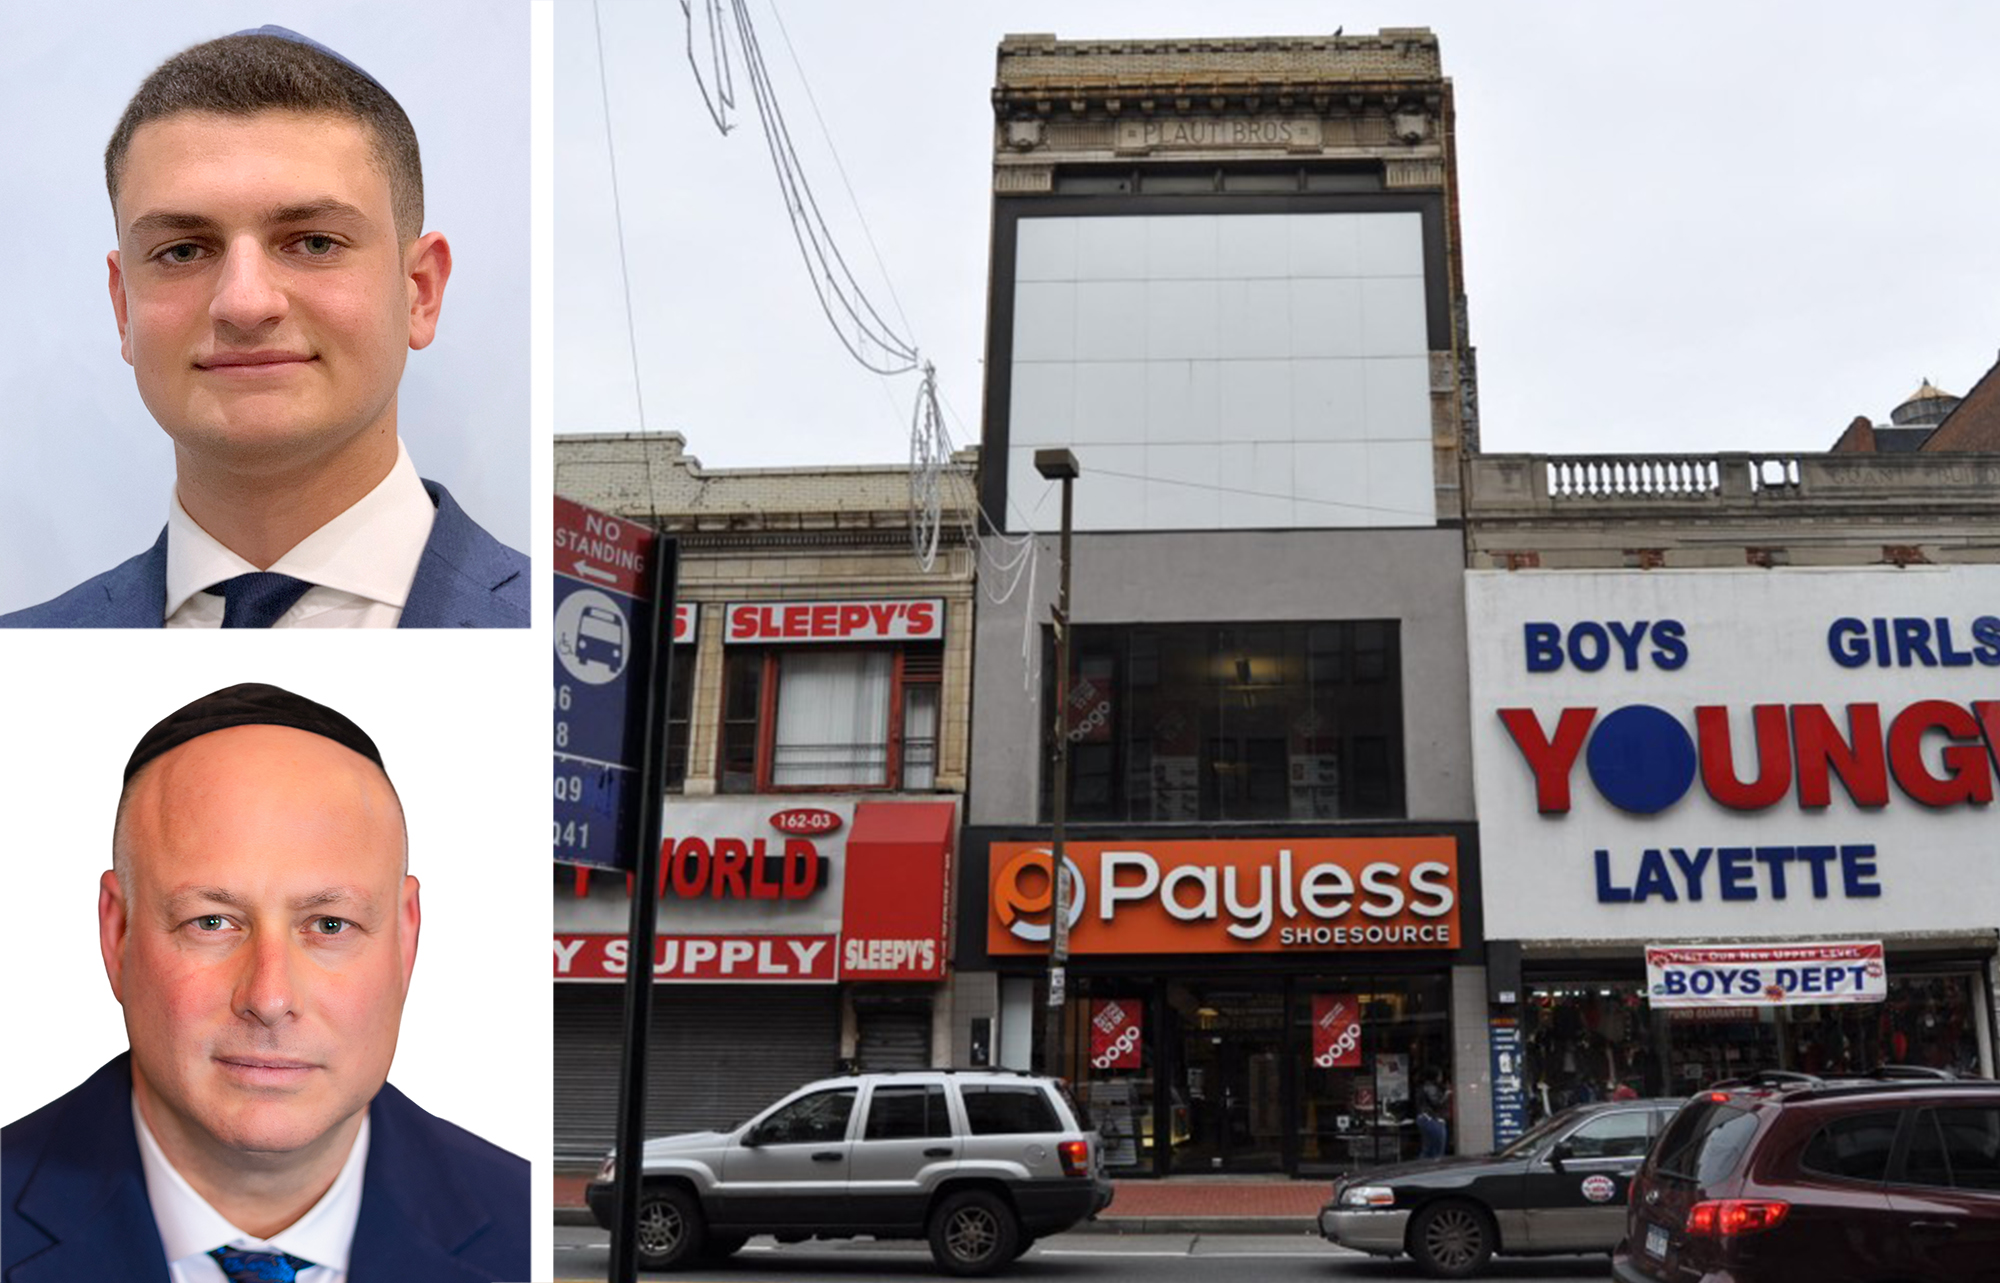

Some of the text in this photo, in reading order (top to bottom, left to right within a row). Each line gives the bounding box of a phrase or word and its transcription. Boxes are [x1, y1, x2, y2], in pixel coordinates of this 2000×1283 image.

[1143, 119, 1292, 143] PLAUT BROS
[586, 513, 620, 542] NO
[554, 526, 645, 574] STANDING
[731, 602, 934, 638] SLEEPY'S
[1524, 620, 1690, 673] BOYS
[1828, 616, 2000, 668] GIRLS
[1066, 701, 1110, 742] bogo
[554, 776, 582, 802] Q9
[779, 813, 831, 829] 162-03
[1594, 844, 1882, 903] LAYETTE
[1100, 849, 1455, 938] Payless
[1280, 925, 1450, 944] SHOESOURCE
[602, 940, 827, 974] SUPPLY
[844, 939, 936, 971] SLEEPY'S
[1664, 968, 1762, 996] BOYS
[1775, 967, 1867, 993] DEPT
[1091, 1026, 1140, 1069] bogo
[1314, 1024, 1361, 1068] bogo
